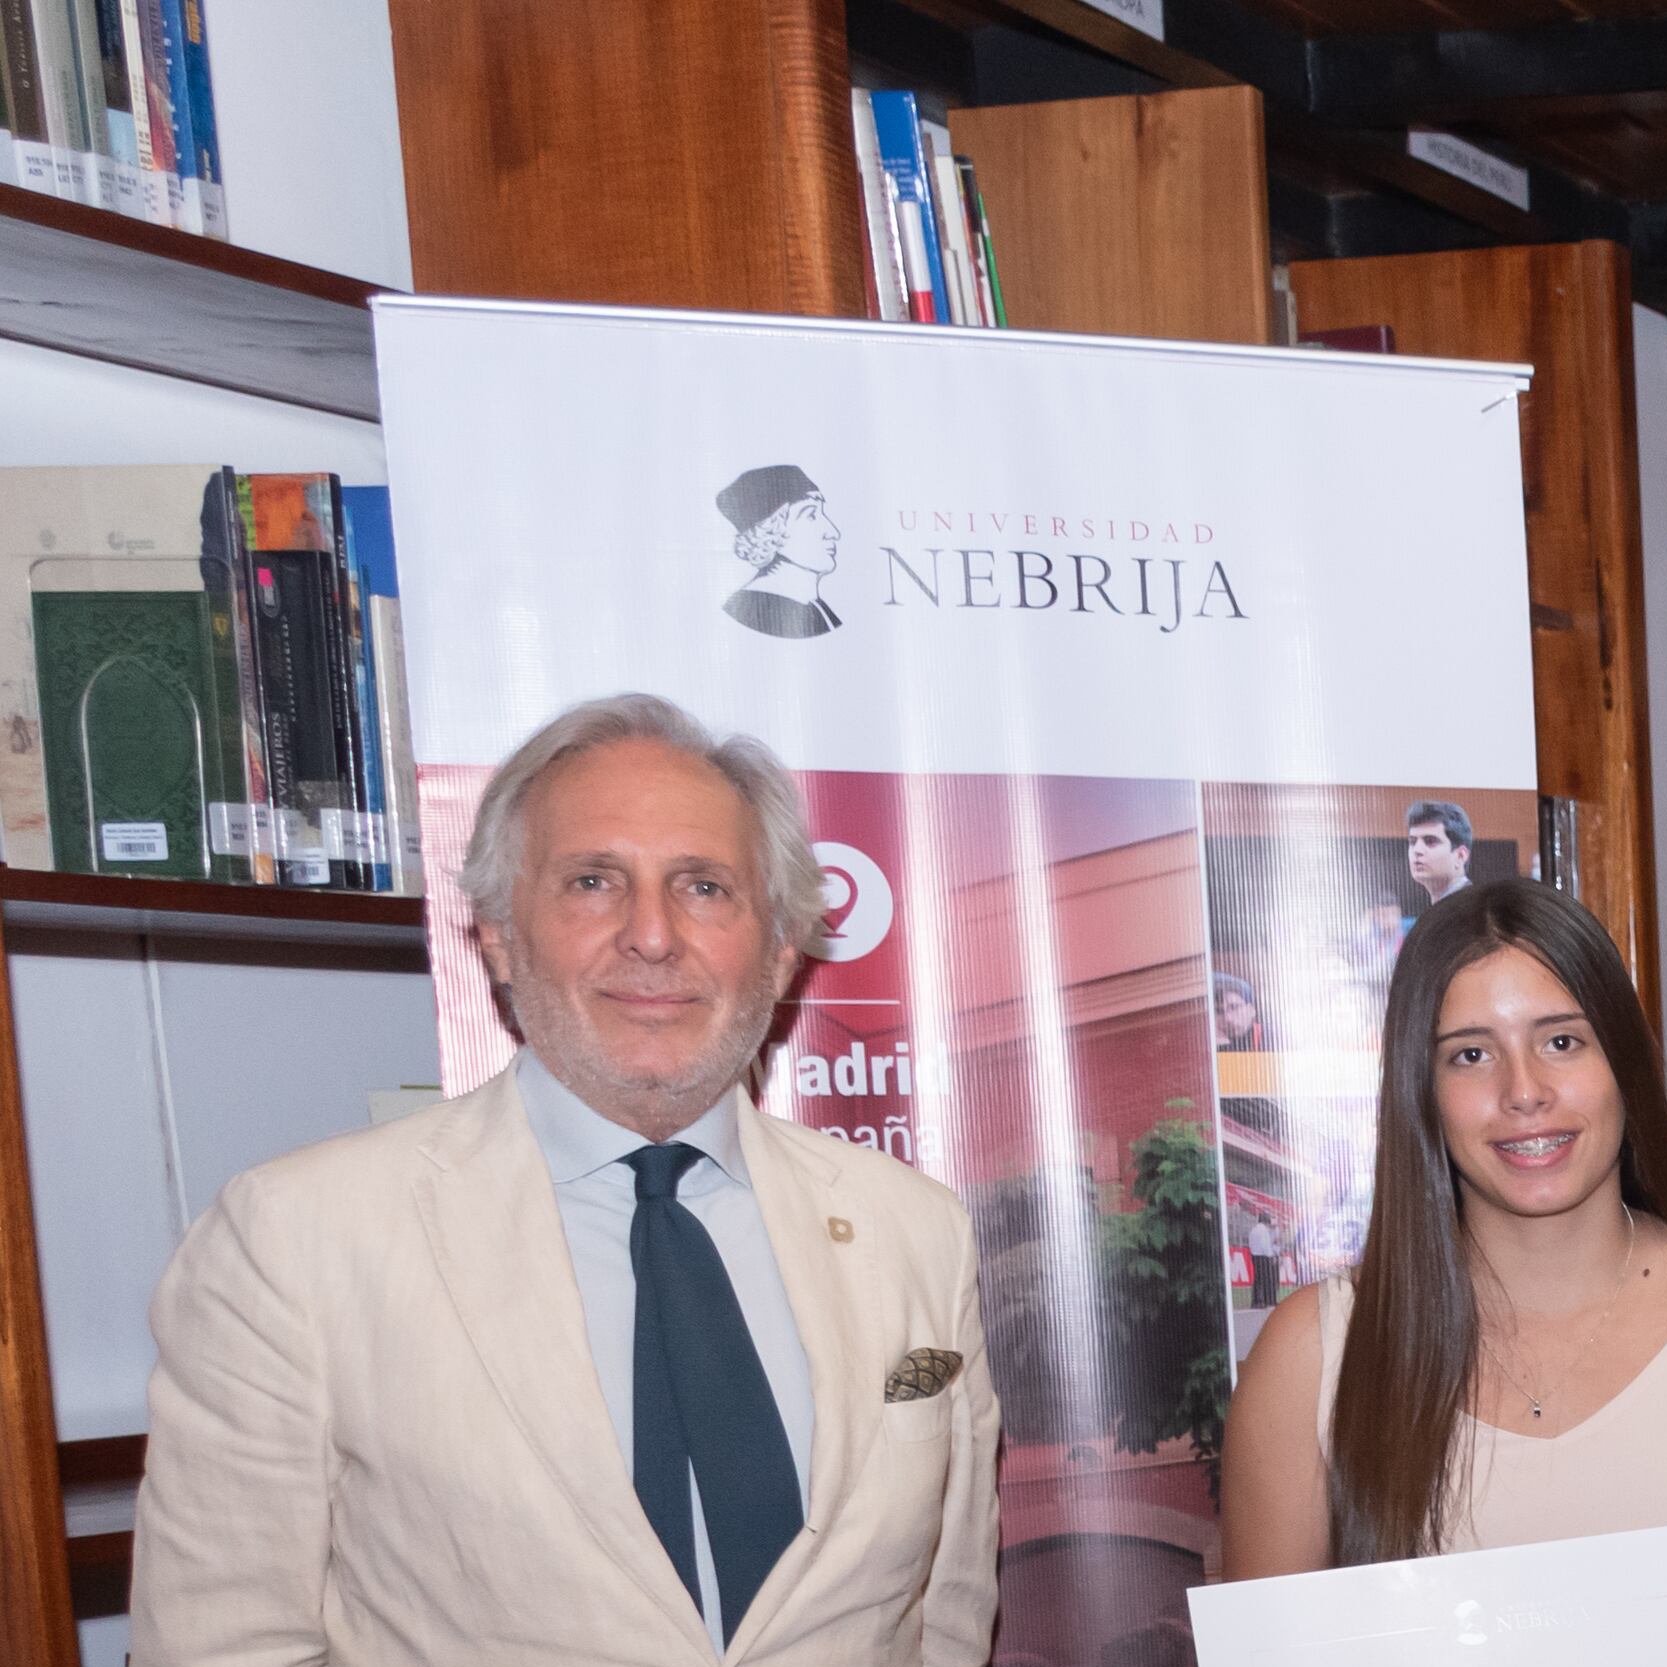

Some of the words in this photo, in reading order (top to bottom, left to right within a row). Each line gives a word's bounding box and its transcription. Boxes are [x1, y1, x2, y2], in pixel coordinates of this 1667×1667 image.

[898, 510, 1217, 545] UNIVERSIDAD
[879, 546, 1250, 634] NEBRIJA
[1496, 1604, 1591, 1633] NEBRA
